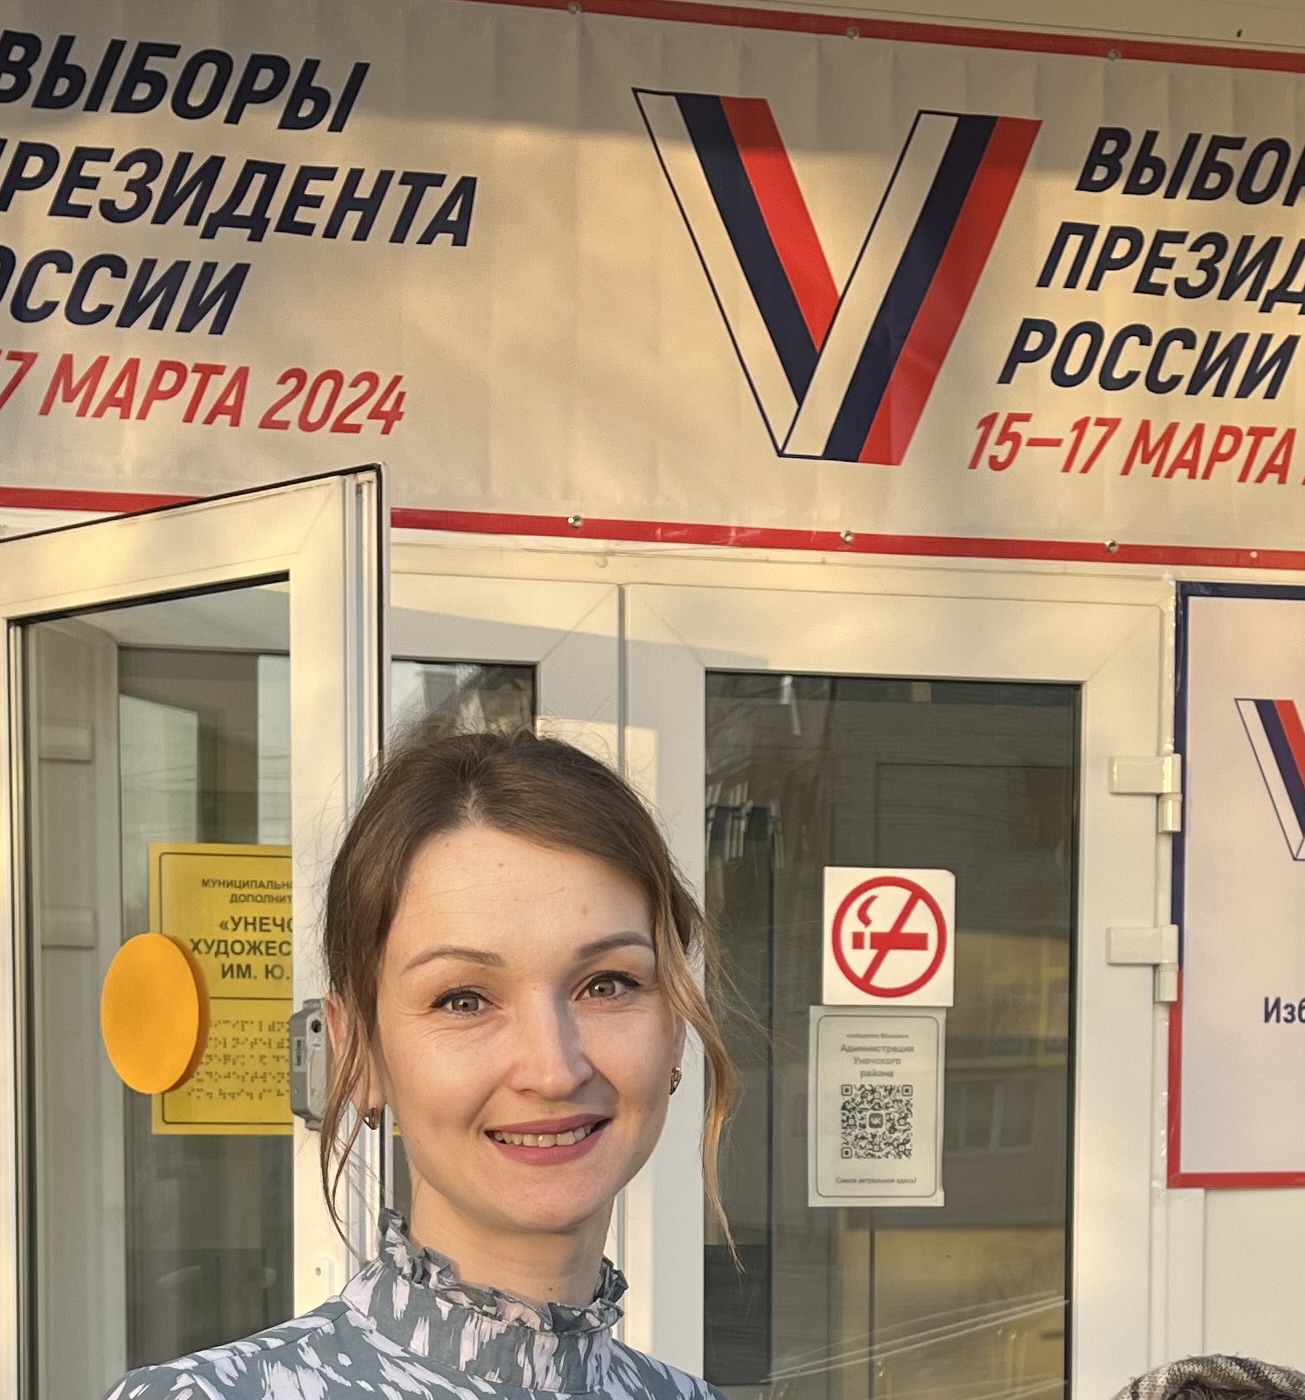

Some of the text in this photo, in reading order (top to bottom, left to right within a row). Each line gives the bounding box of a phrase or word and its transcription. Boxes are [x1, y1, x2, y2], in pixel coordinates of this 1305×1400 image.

[38, 353, 250, 428] МАРТА
[258, 366, 406, 436] 2024
[997, 317, 1301, 400] РОССИИ
[967, 411, 1122, 475] 15–17
[1119, 418, 1298, 485] МАРТА
[189, 938, 292, 959] ХУДОЖЕС
[221, 963, 291, 981] ИМ. Ю.
